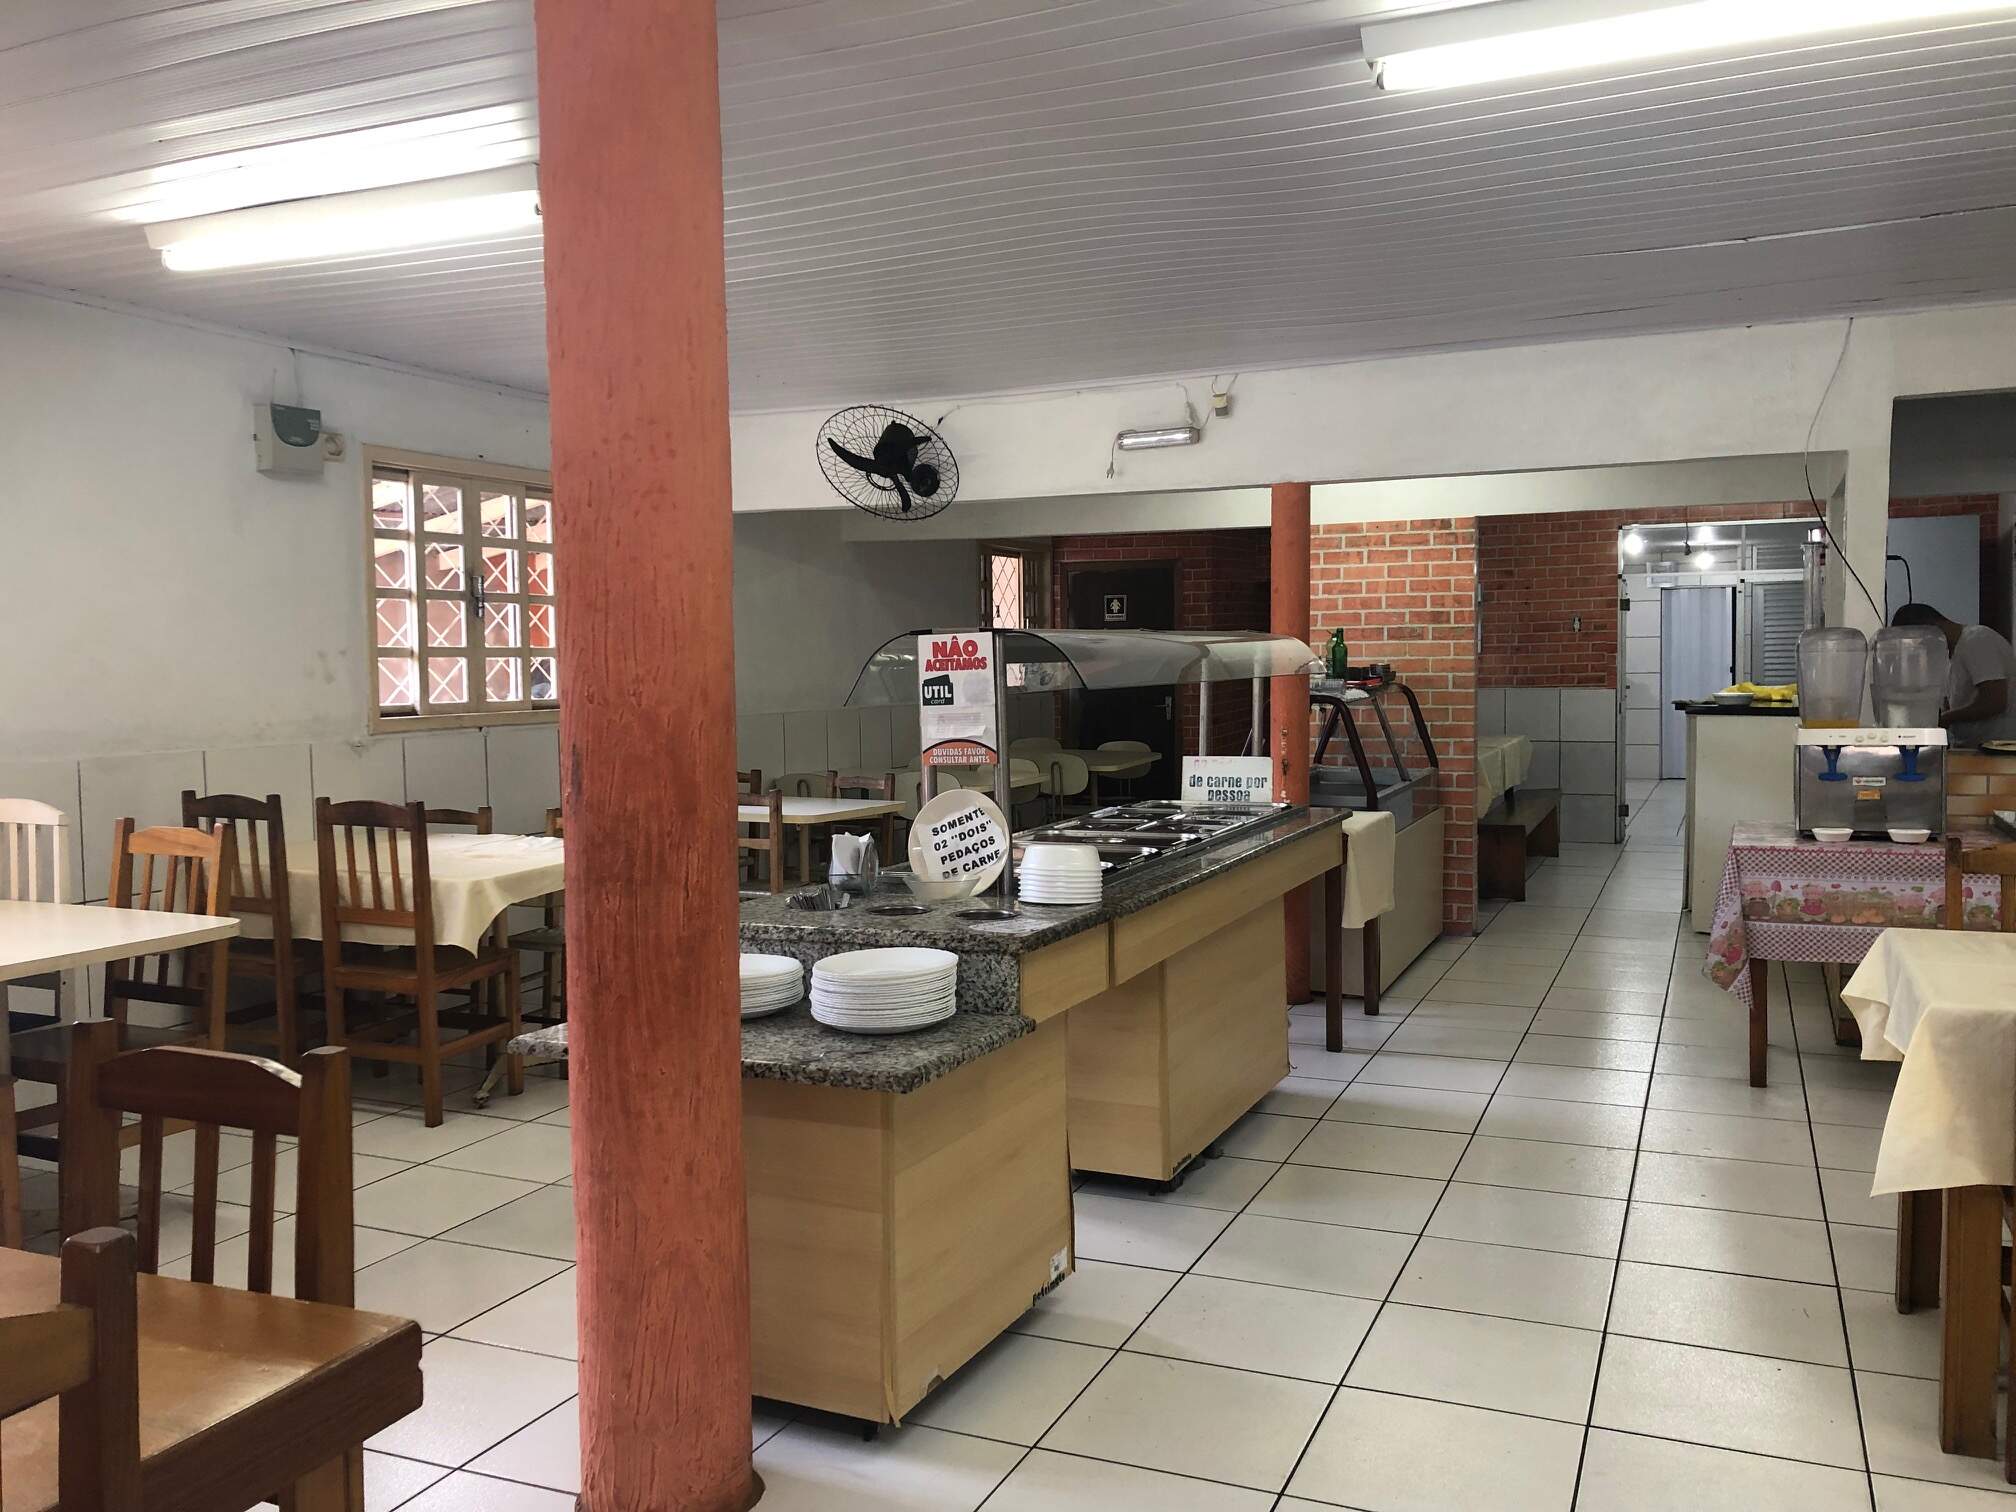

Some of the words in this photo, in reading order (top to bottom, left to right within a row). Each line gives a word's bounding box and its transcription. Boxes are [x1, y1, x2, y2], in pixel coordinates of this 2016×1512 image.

[925, 657, 987, 672] ACEITAMOS
[924, 685, 952, 698] UTIL
[929, 756, 967, 764] CONSULTAR
[1189, 774, 1203, 788] de
[1207, 776, 1242, 788] carne
[1246, 776, 1268, 789] por
[1208, 789, 1250, 801] pessoa
[932, 807, 985, 836] SOMENTE
[934, 840, 948, 851] 02
[941, 836, 996, 865] PEDAÇOS
[942, 867, 959, 879] DE
